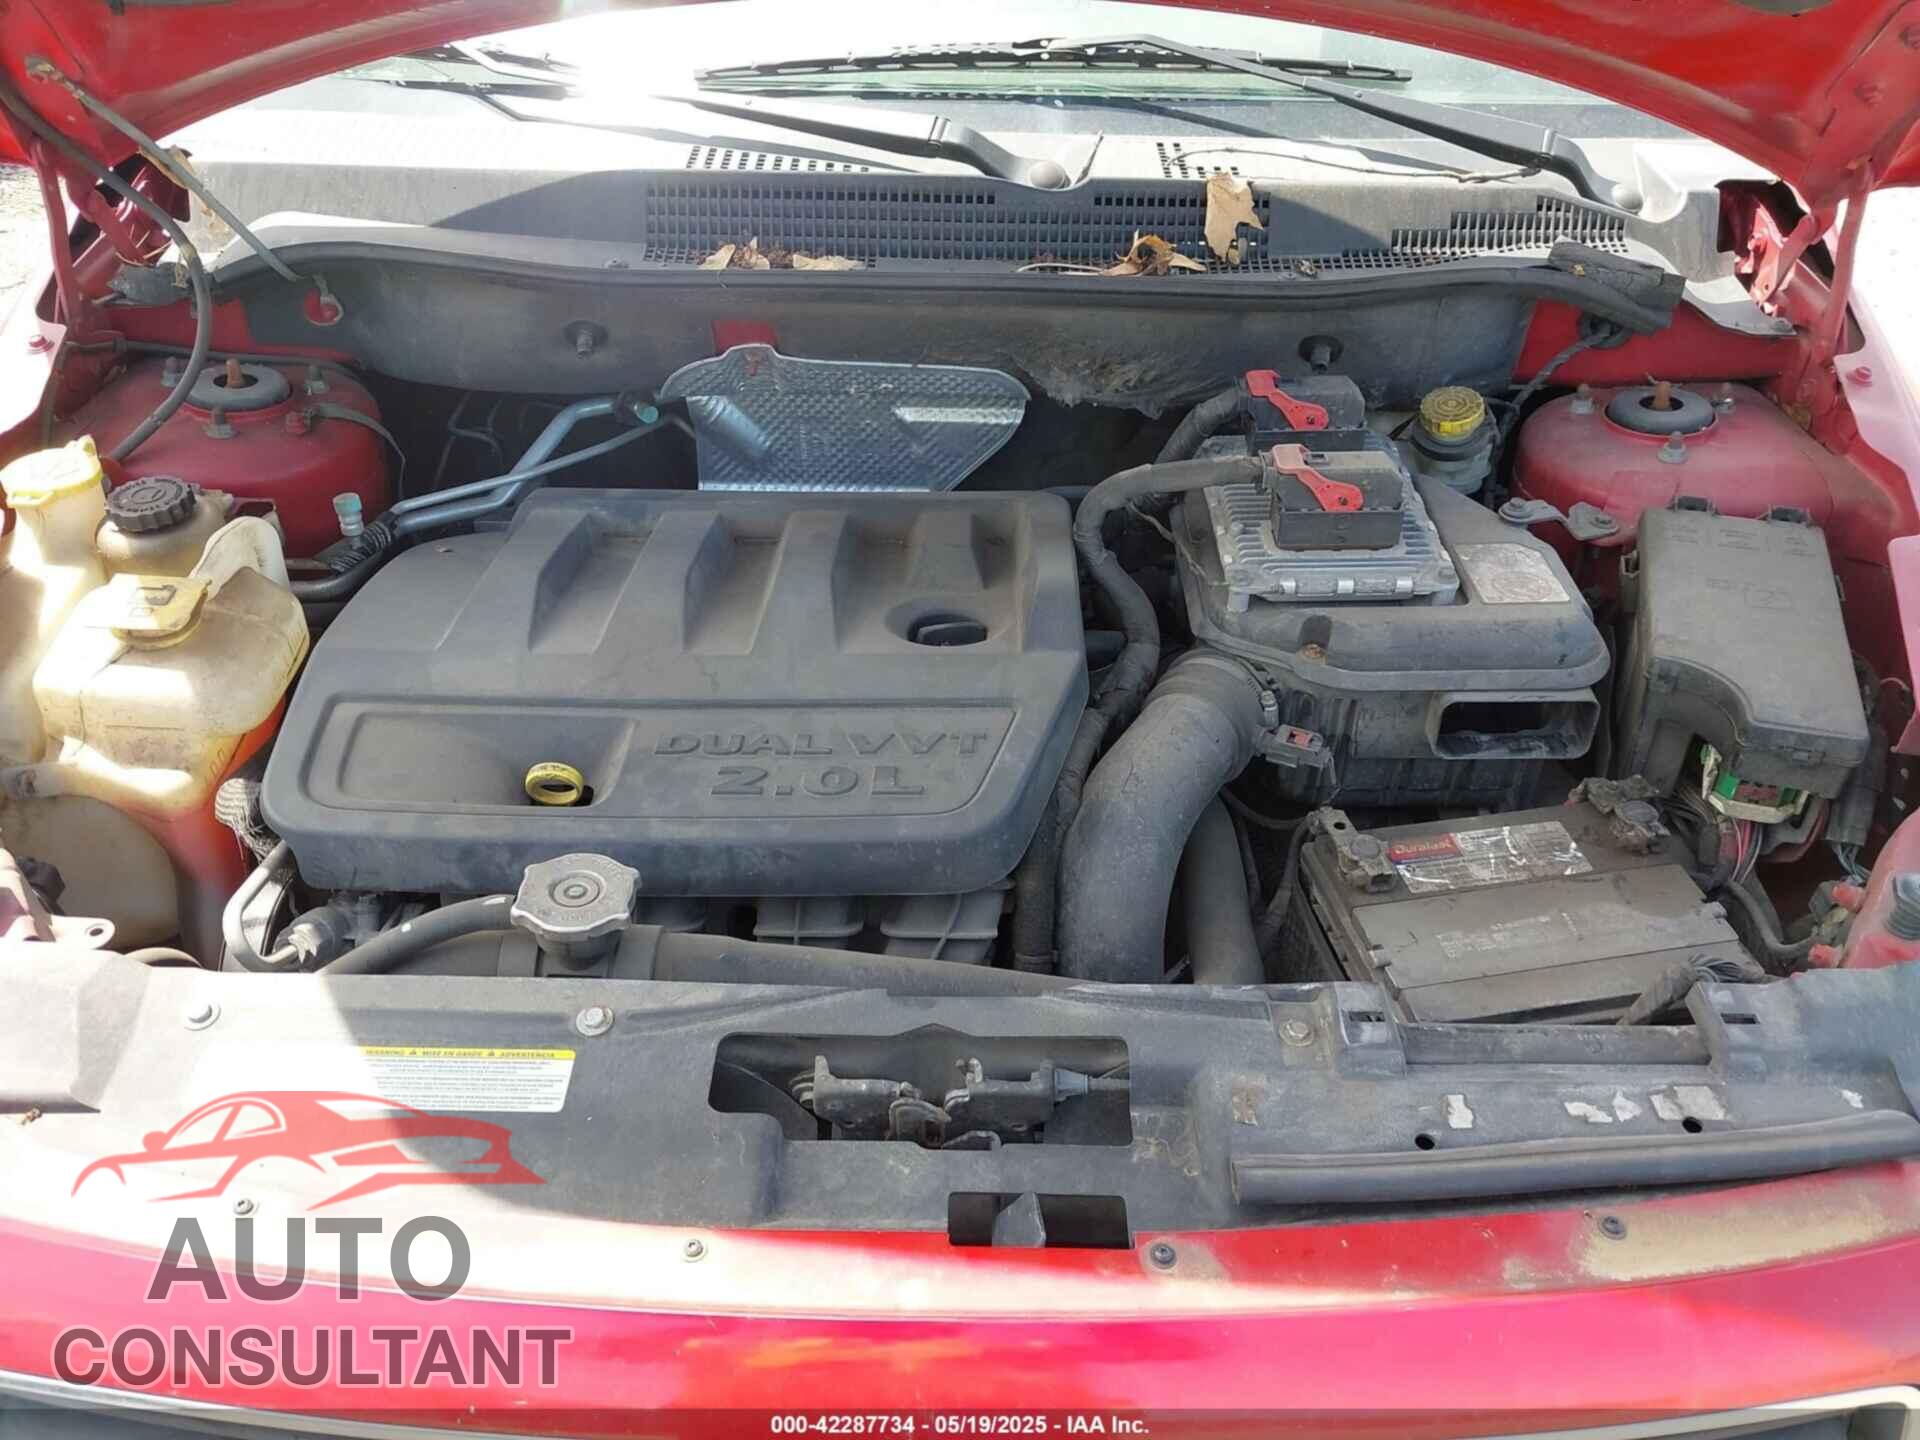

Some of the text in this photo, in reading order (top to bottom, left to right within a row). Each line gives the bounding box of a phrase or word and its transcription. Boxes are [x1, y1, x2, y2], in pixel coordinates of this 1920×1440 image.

[655, 733, 988, 756] DUAL VVT
[710, 765, 924, 796] 2.0L
